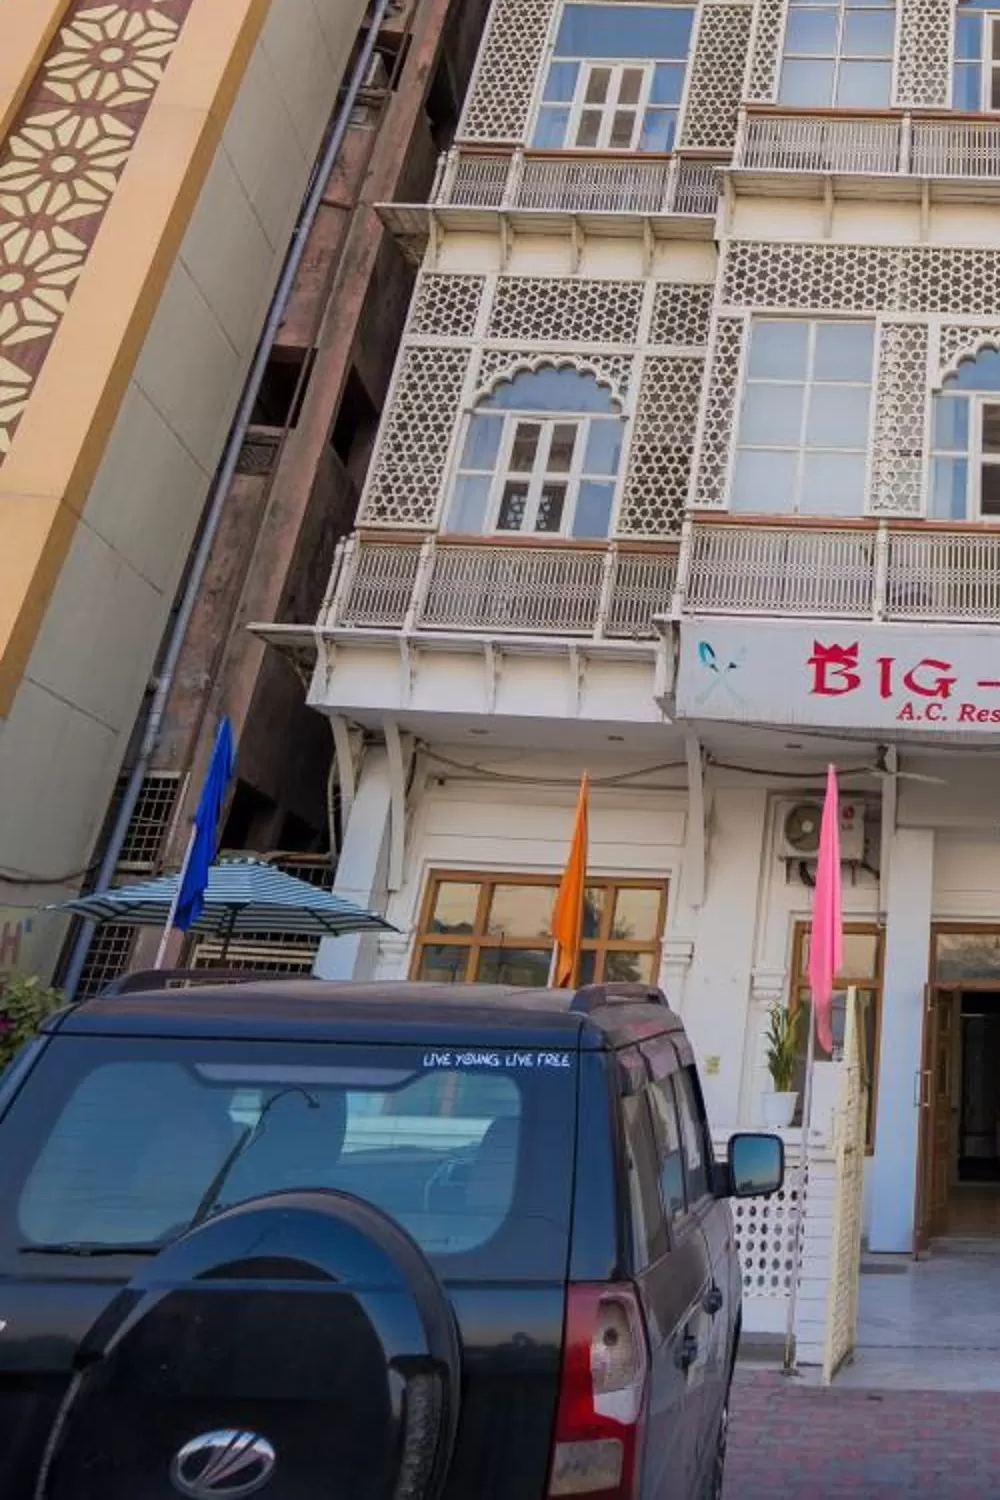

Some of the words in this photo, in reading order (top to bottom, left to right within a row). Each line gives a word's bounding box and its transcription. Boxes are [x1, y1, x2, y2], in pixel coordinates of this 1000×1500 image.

[807, 653, 956, 699] BIG
[896, 702, 948, 722] A.C.
[423, 1053, 451, 1067] LIVE
[455, 1053, 500, 1067] YOUNG
[505, 1052, 533, 1067] LIVE
[537, 1053, 570, 1068] FREE
